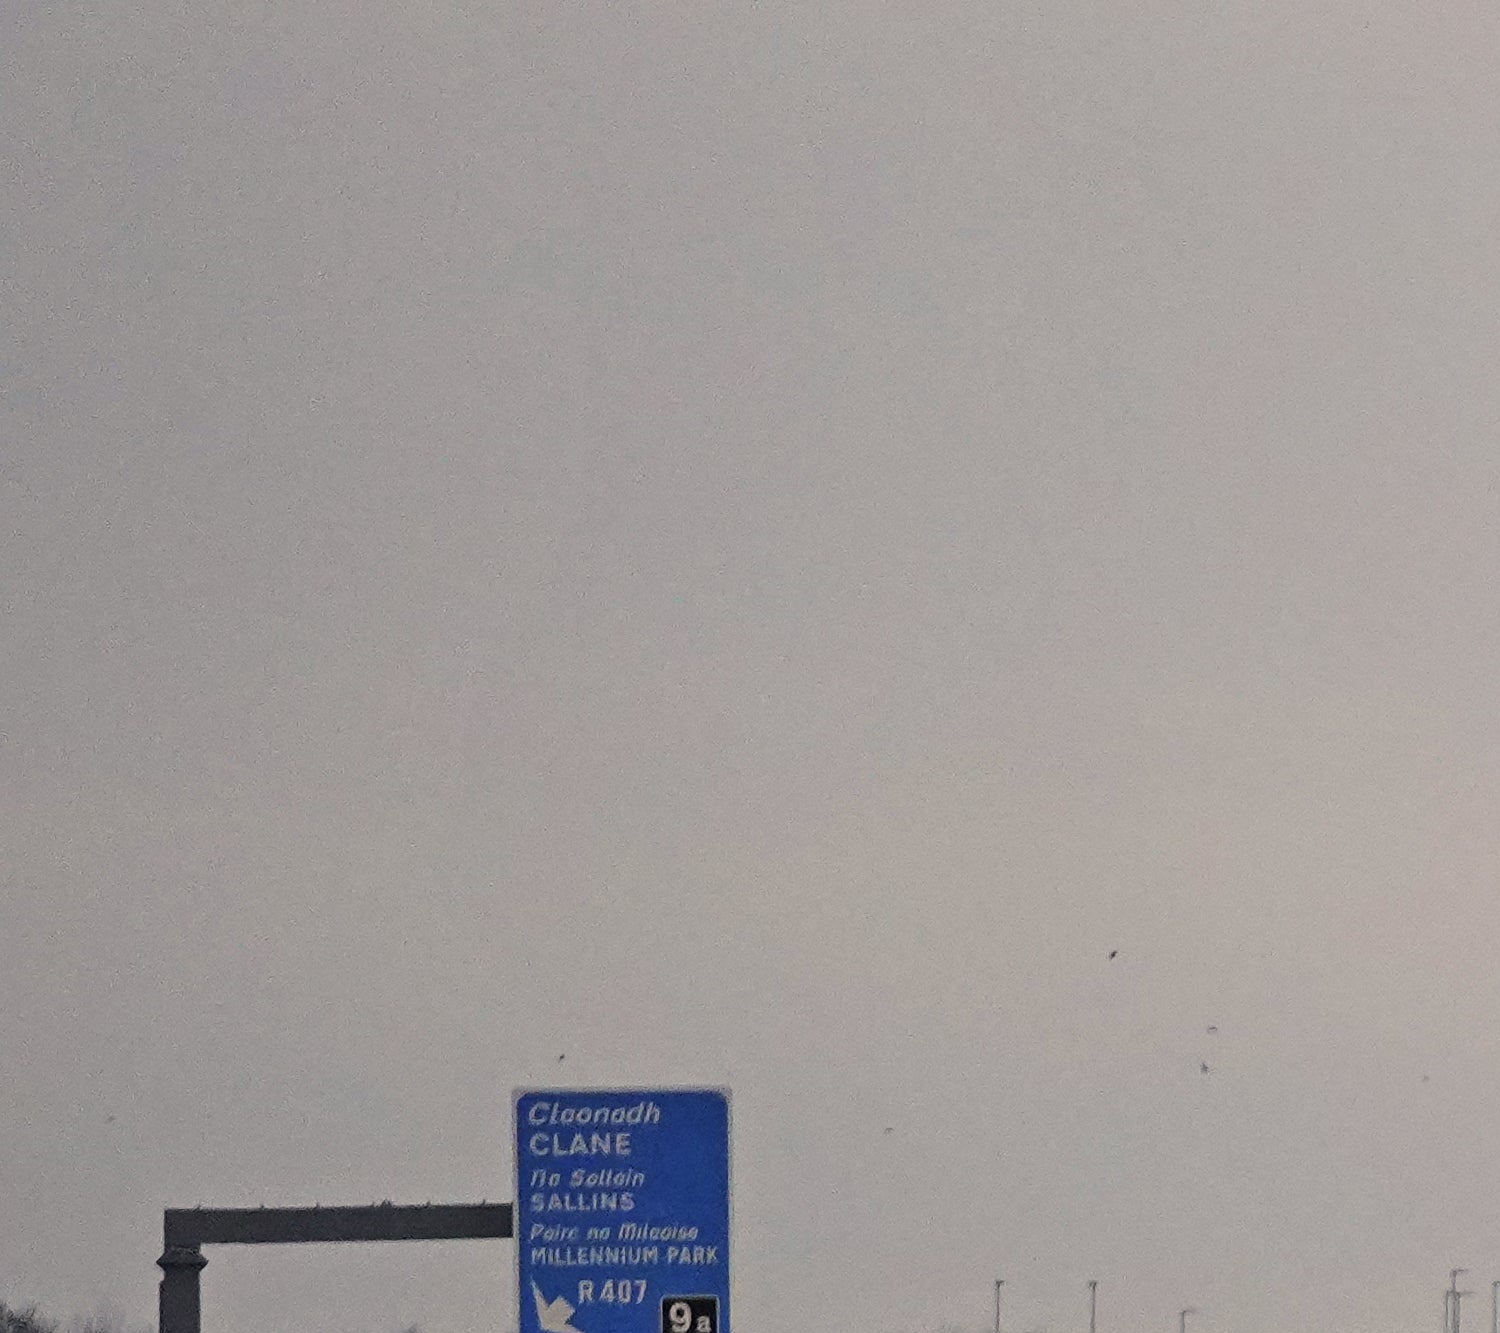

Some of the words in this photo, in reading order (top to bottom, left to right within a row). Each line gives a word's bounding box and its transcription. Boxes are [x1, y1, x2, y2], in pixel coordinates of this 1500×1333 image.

[529, 1132, 632, 1156] CLANE
[531, 1192, 636, 1212] SALLINS
[531, 1246, 658, 1265] MILLENNIUM
[668, 1246, 718, 1264] PARK
[668, 1301, 712, 1333] 9a
